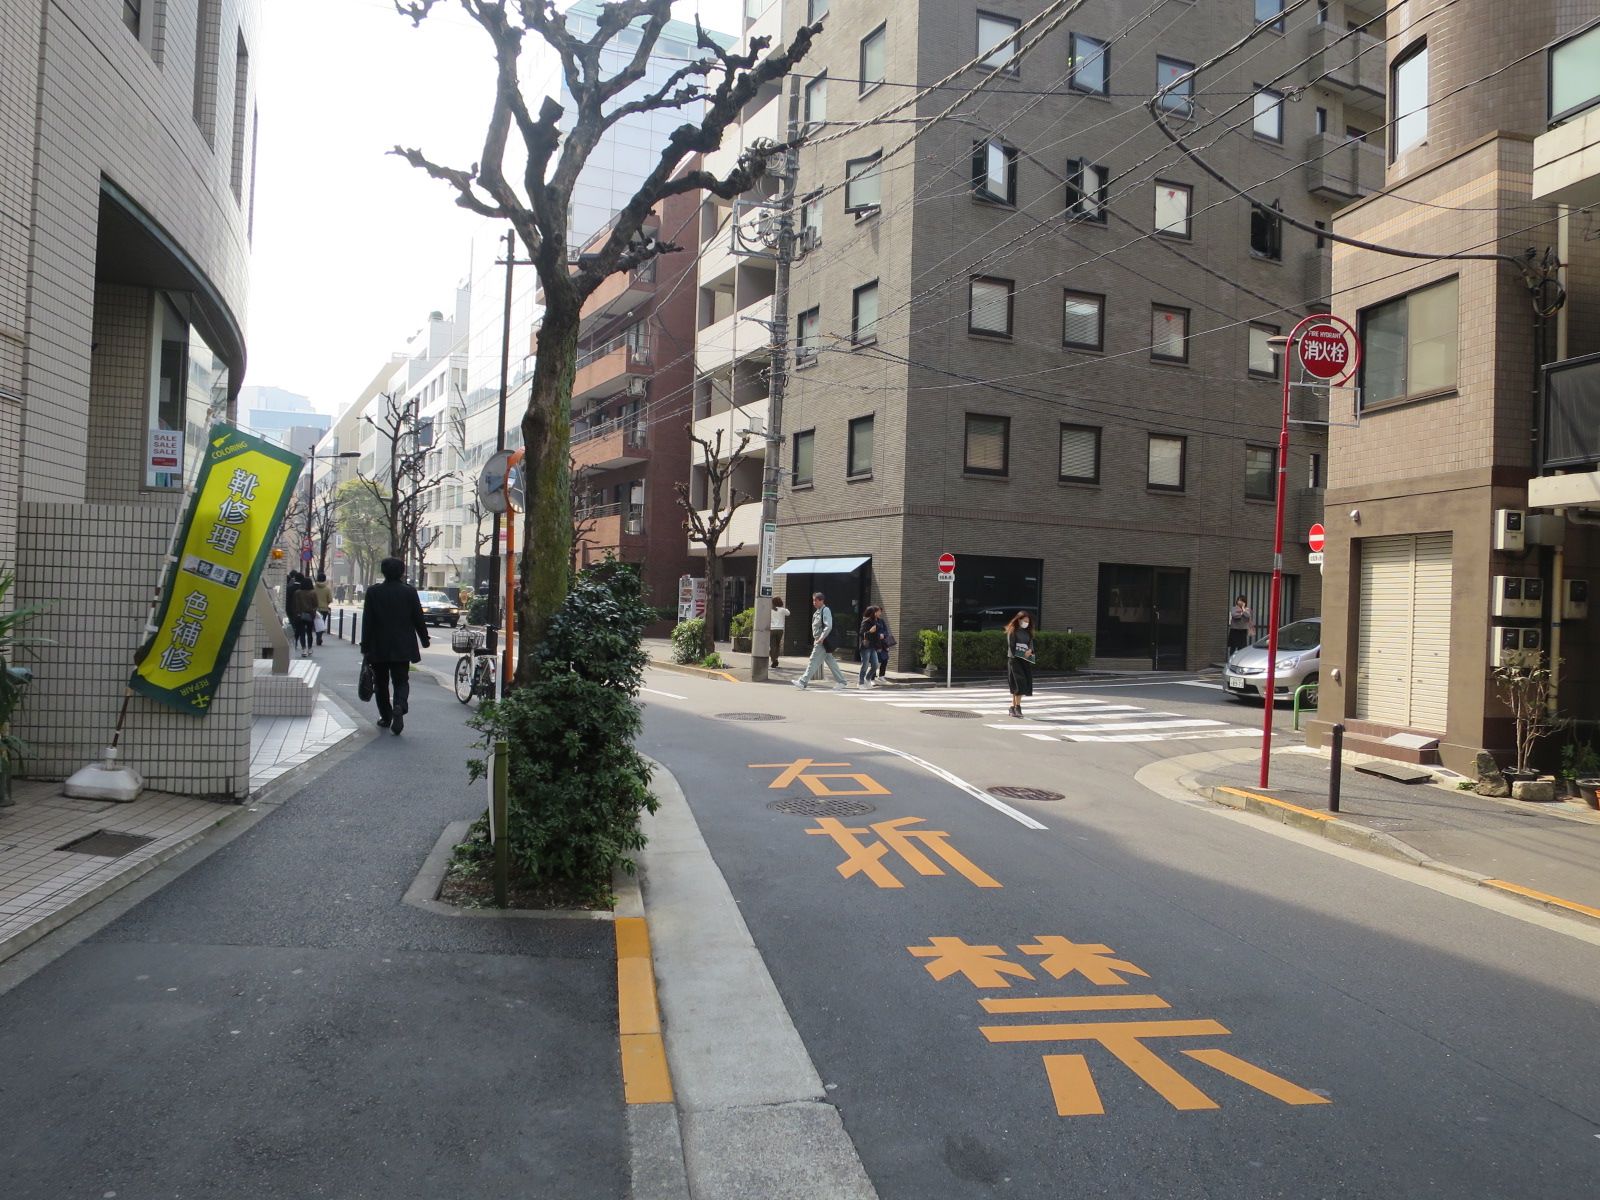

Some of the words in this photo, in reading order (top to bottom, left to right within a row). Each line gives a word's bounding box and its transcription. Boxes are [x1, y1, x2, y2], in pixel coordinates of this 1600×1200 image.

[1320, 331, 1341, 339] HYDRANT
[1304, 339, 1346, 363] 消火栓
[153, 434, 177, 442] SALE
[153, 441, 177, 449] SALE
[153, 448, 177, 456] SALE
[211, 440, 249, 460] COLORING
[207, 467, 260, 555] 靴修理
[159, 590, 209, 673] 色補修
[180, 679, 210, 697] REPAIR
